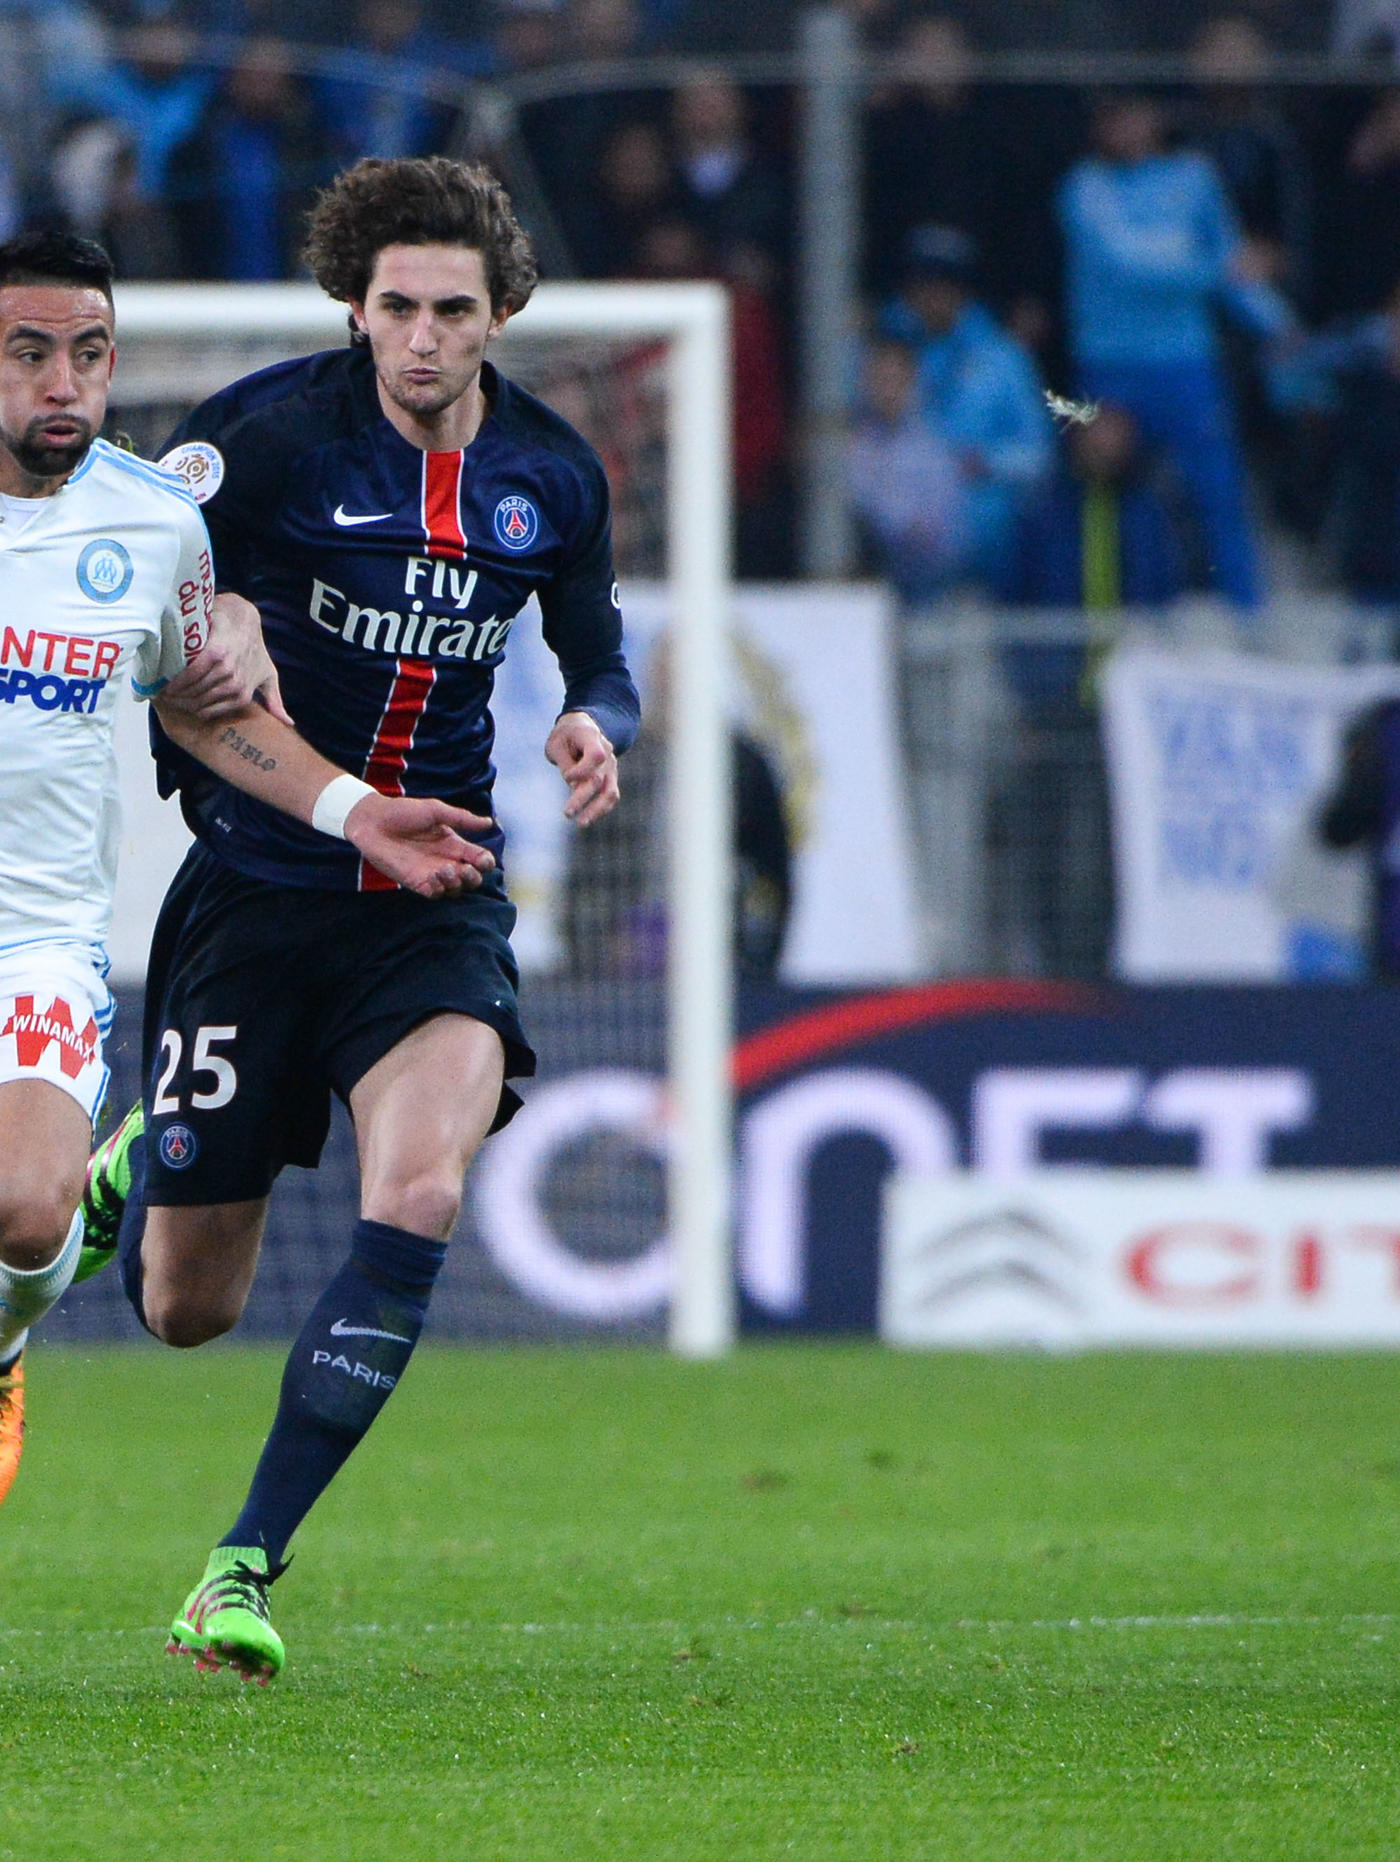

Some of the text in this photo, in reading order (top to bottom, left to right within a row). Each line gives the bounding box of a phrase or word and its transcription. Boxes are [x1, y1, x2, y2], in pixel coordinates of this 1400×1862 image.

[500, 498, 528, 512] PARIS
[178, 580, 199, 617] du
[405, 556, 478, 609] Fly
[12, 1013, 94, 1063] WINAMAX
[152, 1026, 237, 1115] 25
[312, 1350, 396, 1389] PARIS
